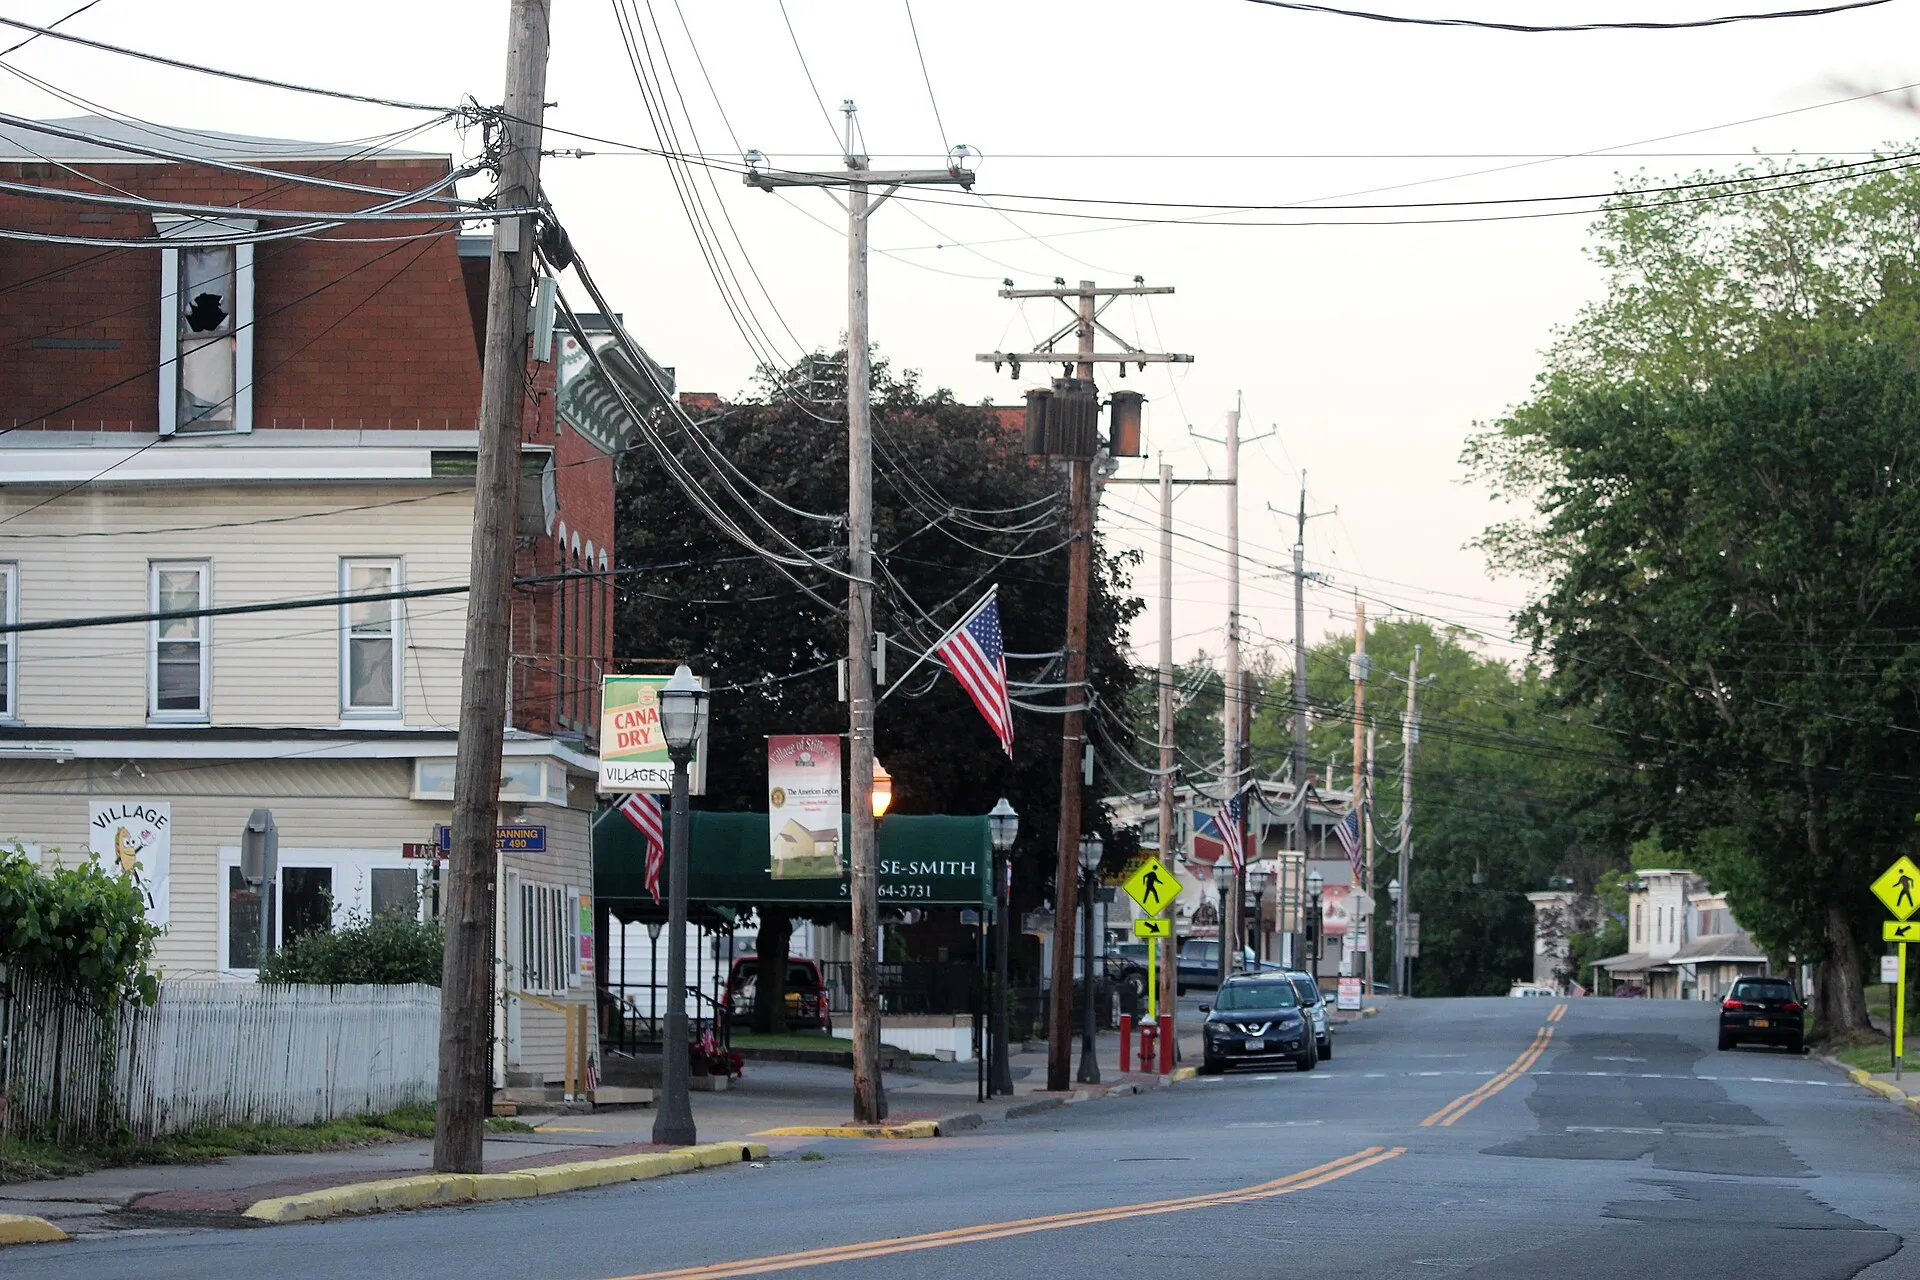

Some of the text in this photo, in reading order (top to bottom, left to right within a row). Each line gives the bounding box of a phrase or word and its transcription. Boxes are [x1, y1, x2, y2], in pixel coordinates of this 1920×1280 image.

[614, 707, 659, 730] CANA
[616, 727, 651, 748] DRY
[769, 743, 796, 765] Village
[795, 737, 805, 752] of
[606, 768, 675, 782] VILLAGE DE
[787, 788, 839, 797] The American Legion
[92, 805, 168, 829] VILLAGE
[509, 839, 527, 849] 490
[879, 860, 977, 875] SE-SMITH
